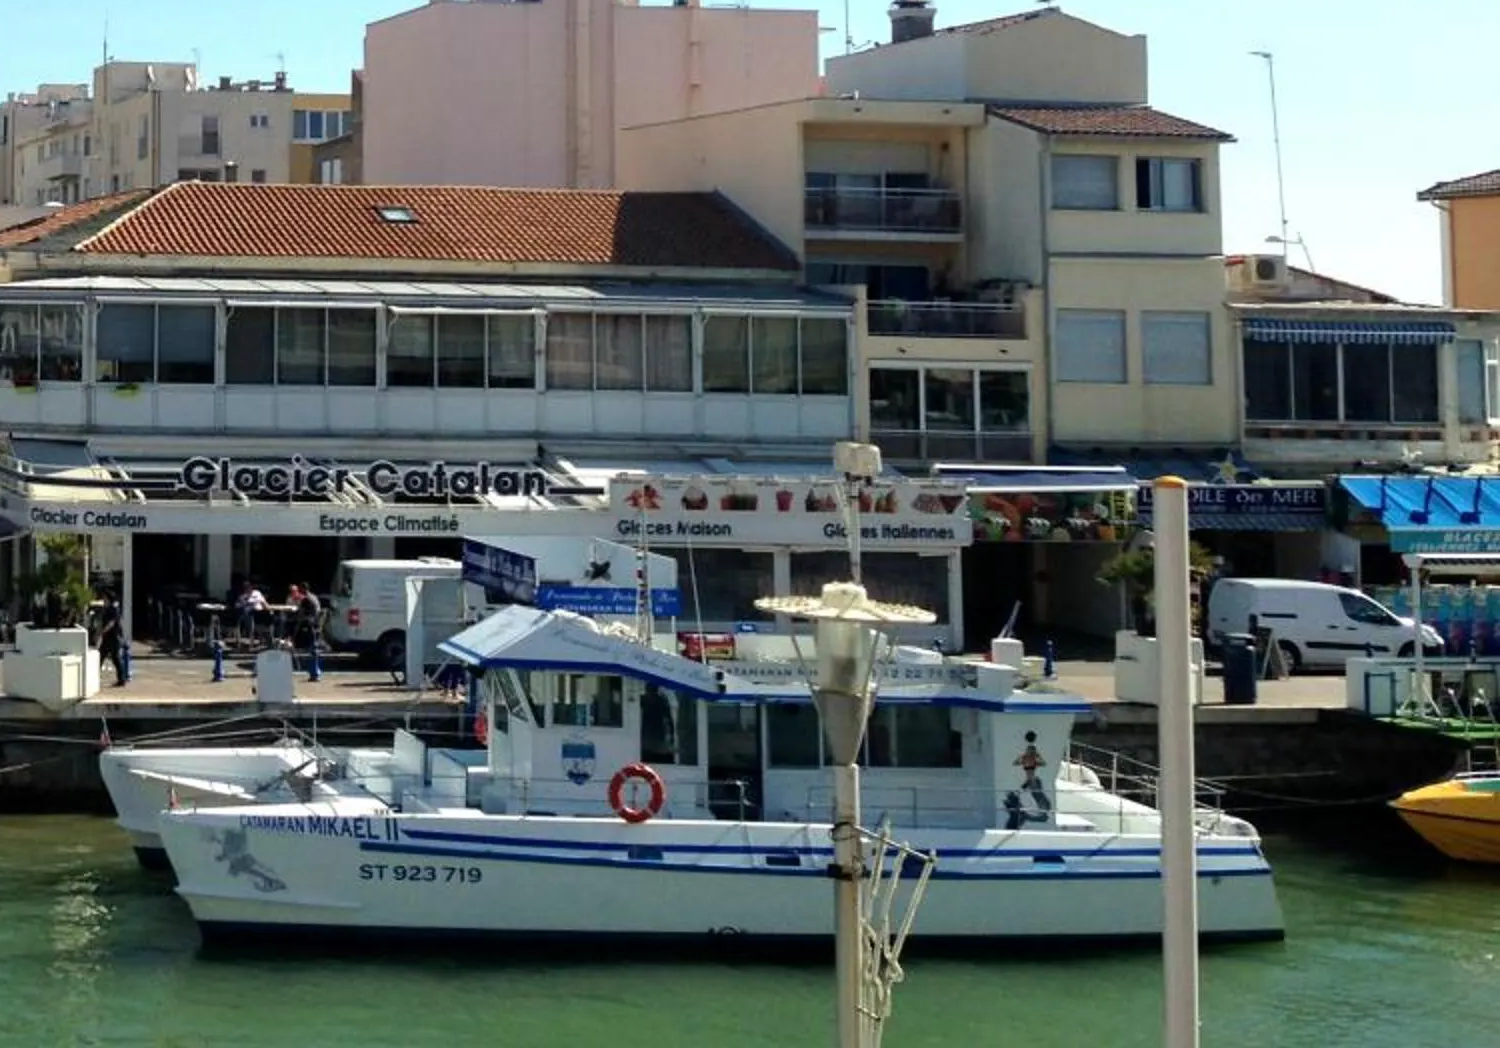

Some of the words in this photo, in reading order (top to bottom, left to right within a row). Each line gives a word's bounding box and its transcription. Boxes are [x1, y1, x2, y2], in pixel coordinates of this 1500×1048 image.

[182, 454, 351, 494] Glacier
[365, 459, 548, 497] Catalan
[1271, 489, 1318, 503] MER
[30, 507, 77, 525] Glacier
[83, 510, 147, 528] Catalan
[319, 514, 378, 533] Espace
[384, 513, 459, 532] Climatisé
[677, 520, 731, 536] Maison
[881, 522, 955, 540] Italiennes
[239, 815, 305, 833] CATAMARAN
[307, 814, 380, 840] MIKAEL
[385, 817, 399, 841] II
[359, 863, 389, 881] ST
[394, 864, 436, 883] 923
[442, 866, 482, 884] 719
